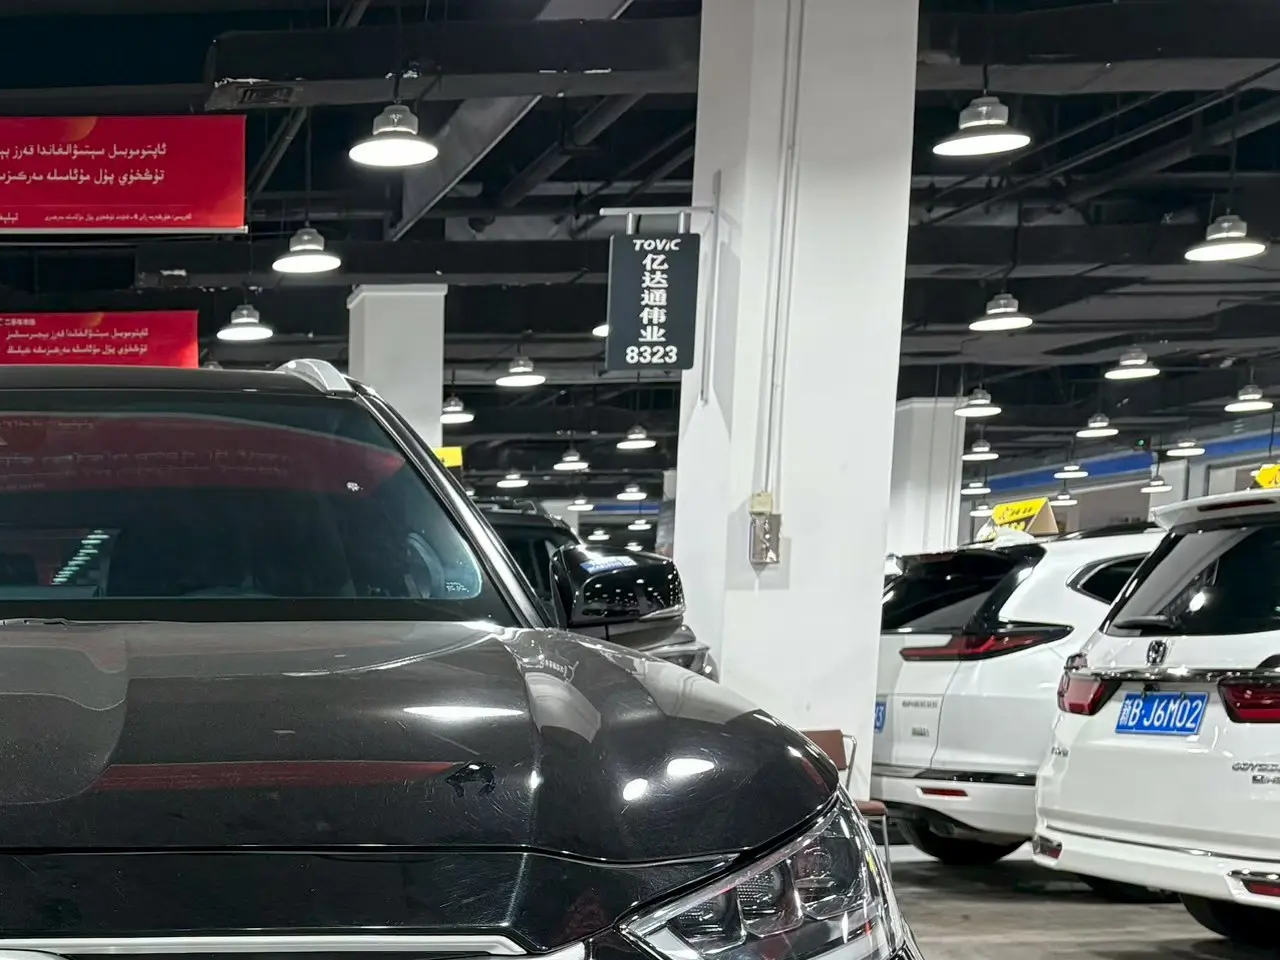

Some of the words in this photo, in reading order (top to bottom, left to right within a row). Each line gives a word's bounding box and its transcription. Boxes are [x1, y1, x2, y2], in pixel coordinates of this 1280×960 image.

[633, 238, 682, 251] TOVIC
[638, 253, 669, 342] 亿达通伟业
[625, 345, 678, 364] 8323
